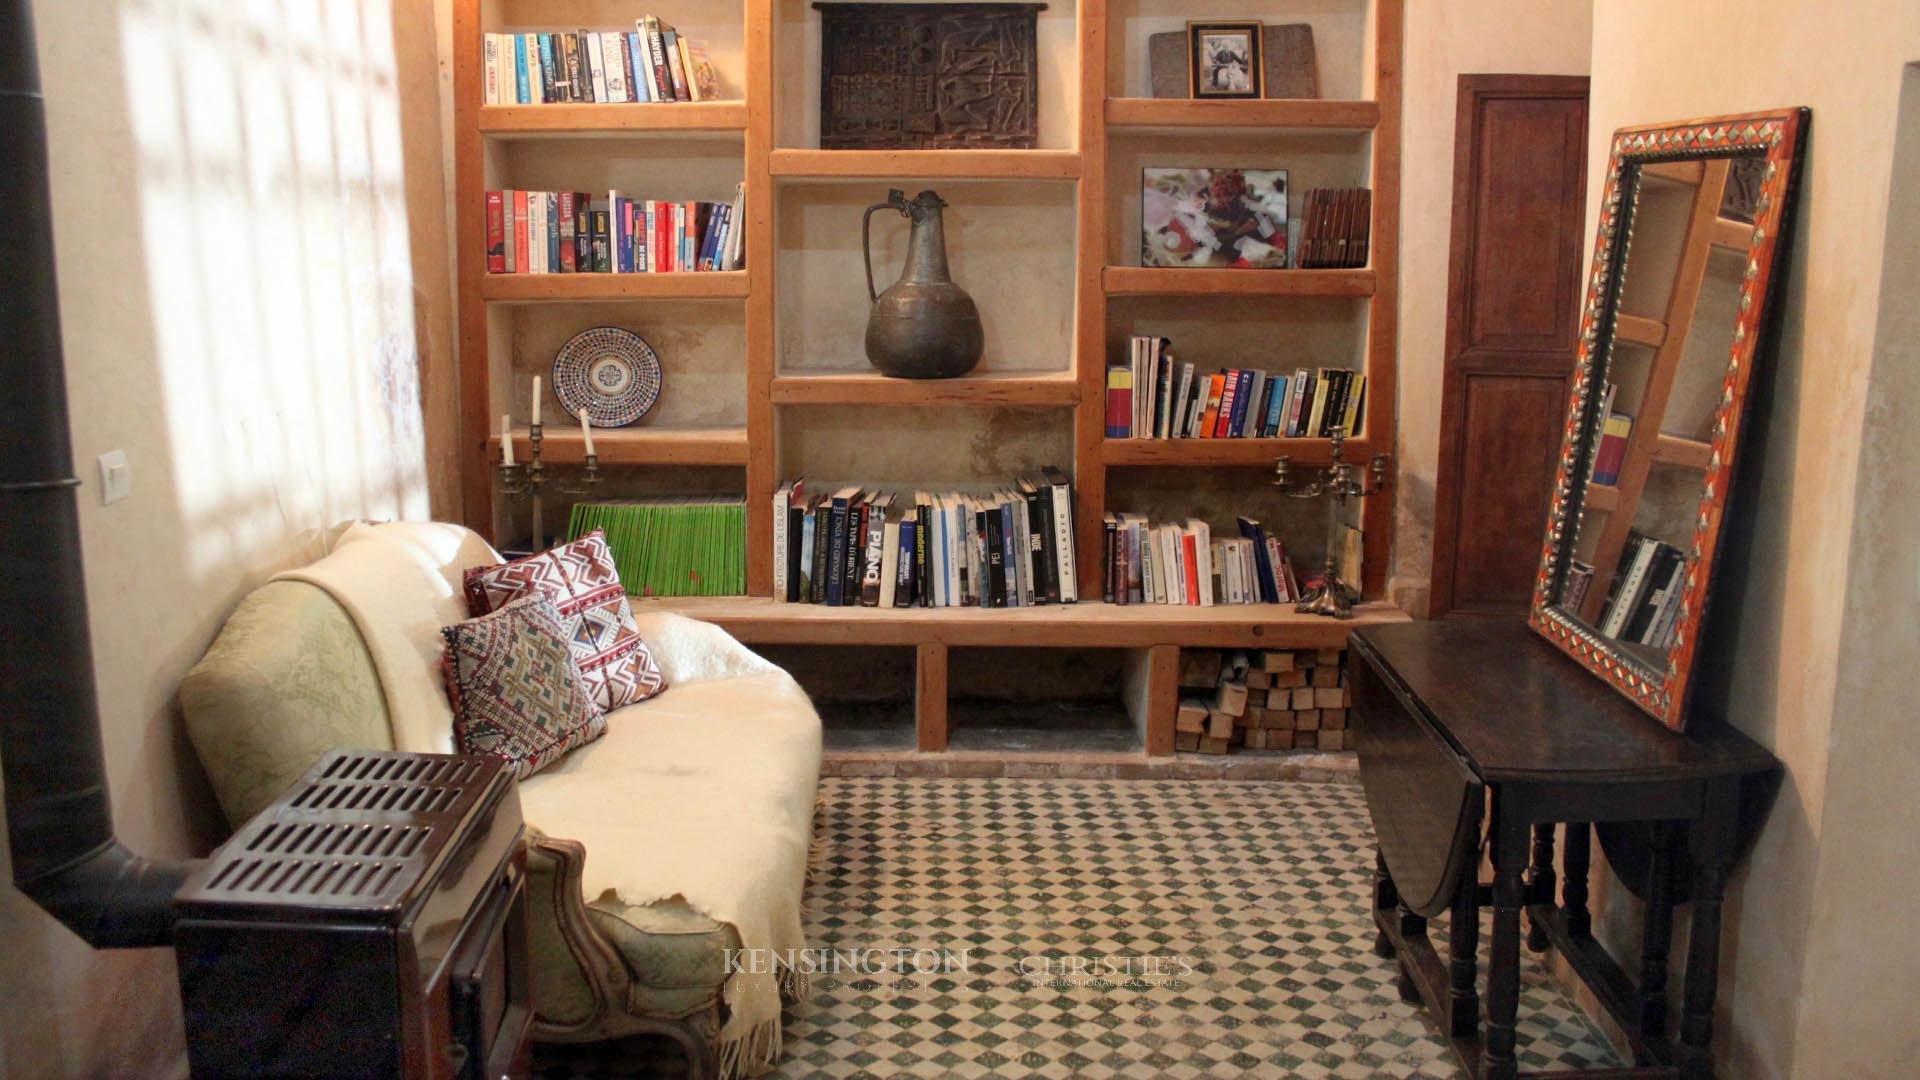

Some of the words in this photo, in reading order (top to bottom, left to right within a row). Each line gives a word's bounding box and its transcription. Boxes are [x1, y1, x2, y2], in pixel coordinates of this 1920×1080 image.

[834, 515, 843, 537] VINCI
[850, 512, 859, 526] LES
[776, 531, 785, 543] DE
[833, 537, 841, 549] DE
[917, 524, 925, 565] moderne
[1031, 533, 1042, 552] INDE
[1060, 513, 1070, 576] PALLADIO
[866, 530, 882, 580] PIANO
[991, 552, 1000, 565] PEI
